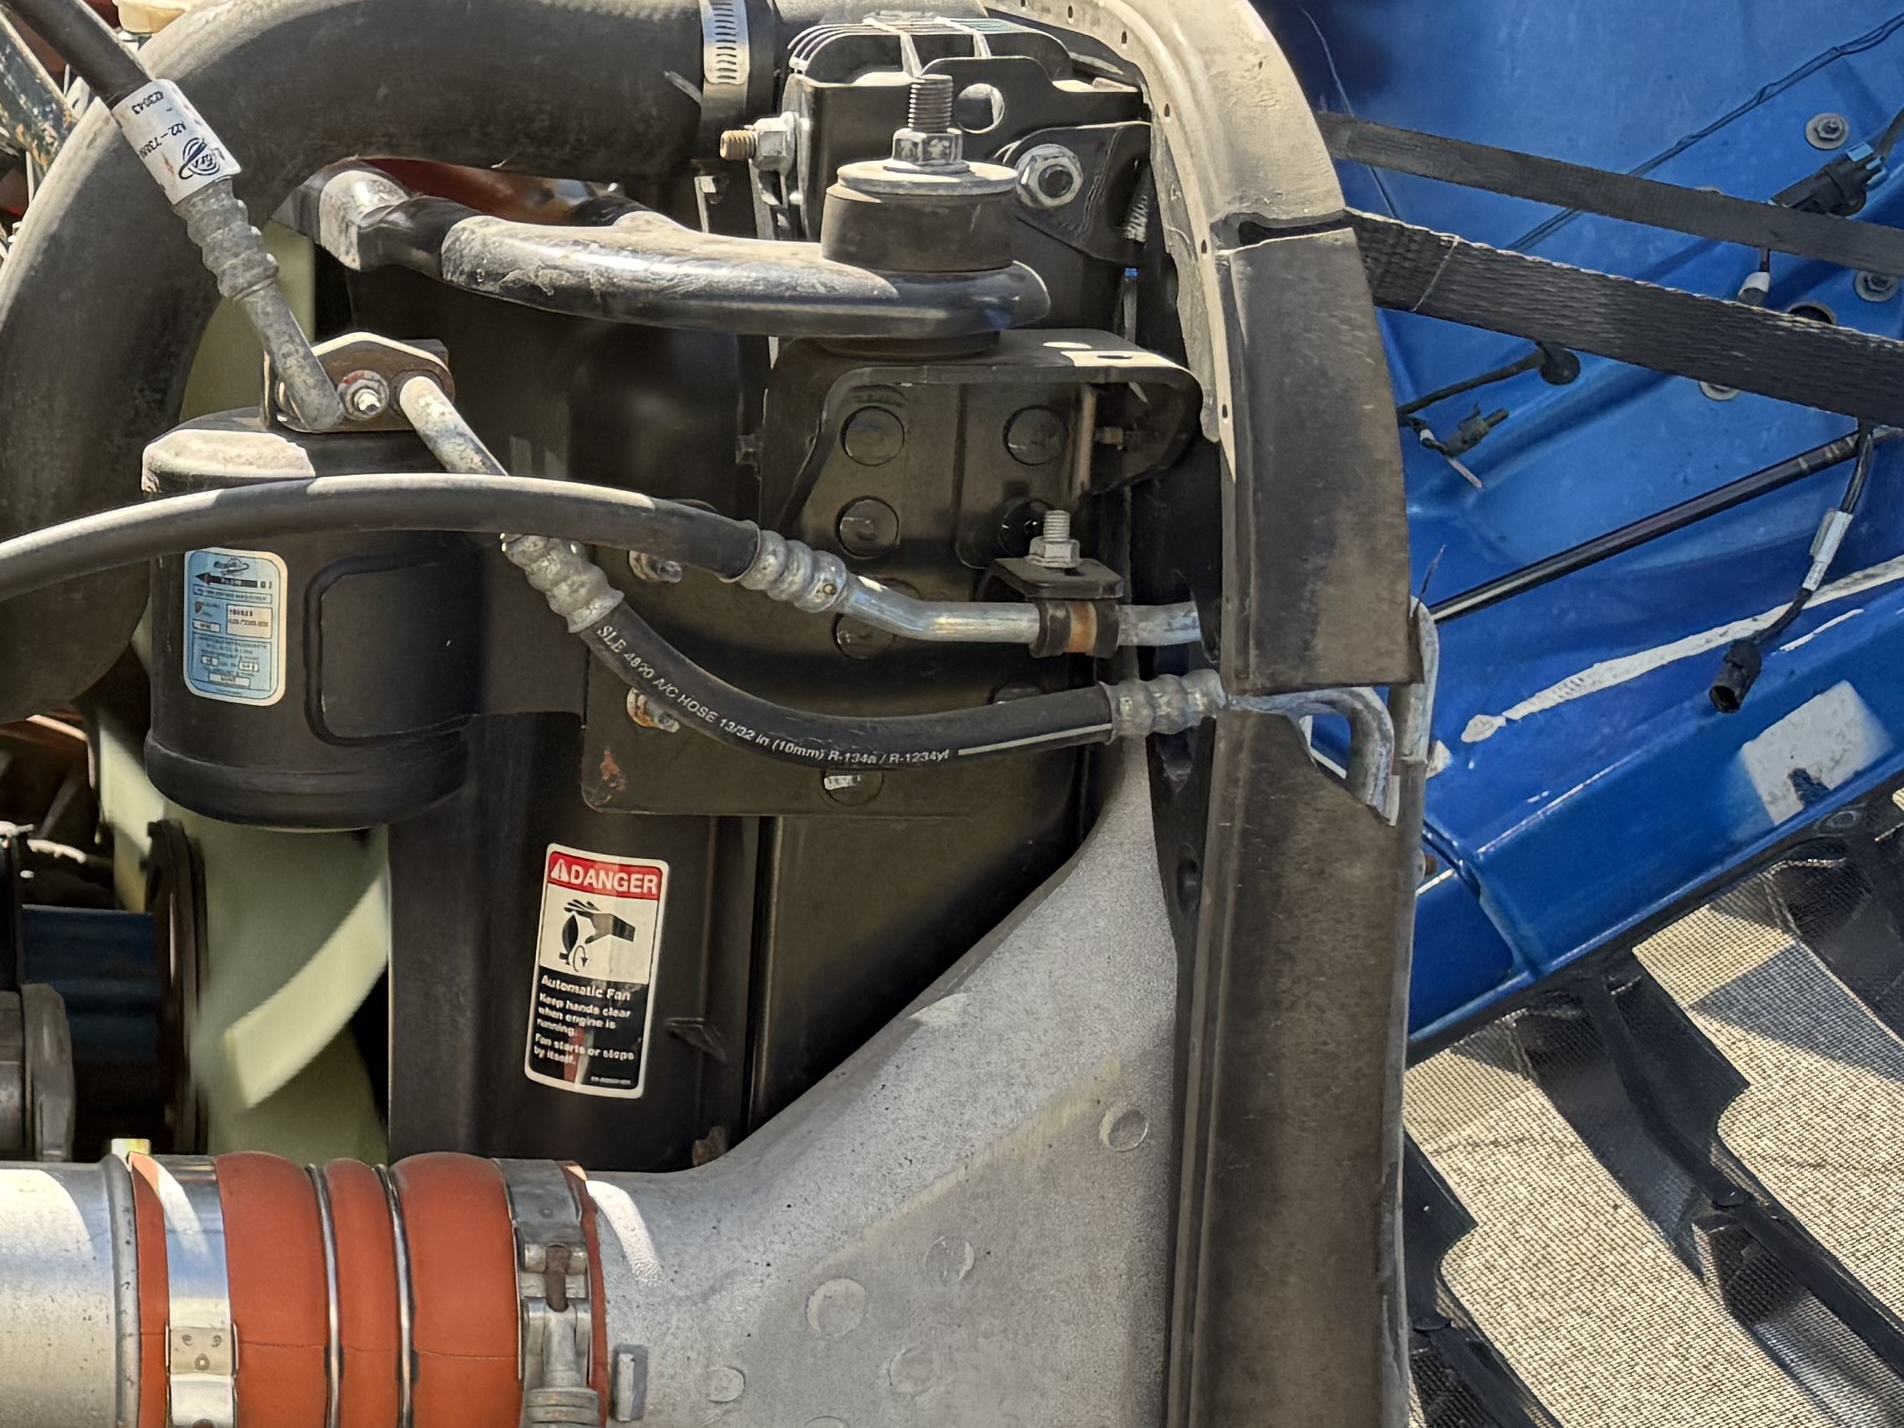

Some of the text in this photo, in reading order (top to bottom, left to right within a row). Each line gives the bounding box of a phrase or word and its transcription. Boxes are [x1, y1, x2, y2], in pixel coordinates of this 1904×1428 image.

[597, 625, 627, 653] SLE
[653, 678, 678, 698] A/C
[677, 694, 719, 723] HOSE
[720, 719, 756, 741] 13/32
[755, 734, 770, 746] in
[772, 739, 824, 760] (10mm)
[828, 750, 877, 764] R-134a
[569, 866, 659, 895] DANGER
[542, 975, 631, 1002] Automatic Fan
[538, 1006, 616, 1030] when engine is
[539, 992, 631, 1018] Keep hands clear
[533, 1044, 546, 1059] by
[535, 1033, 635, 1061] Fan starts or stops
